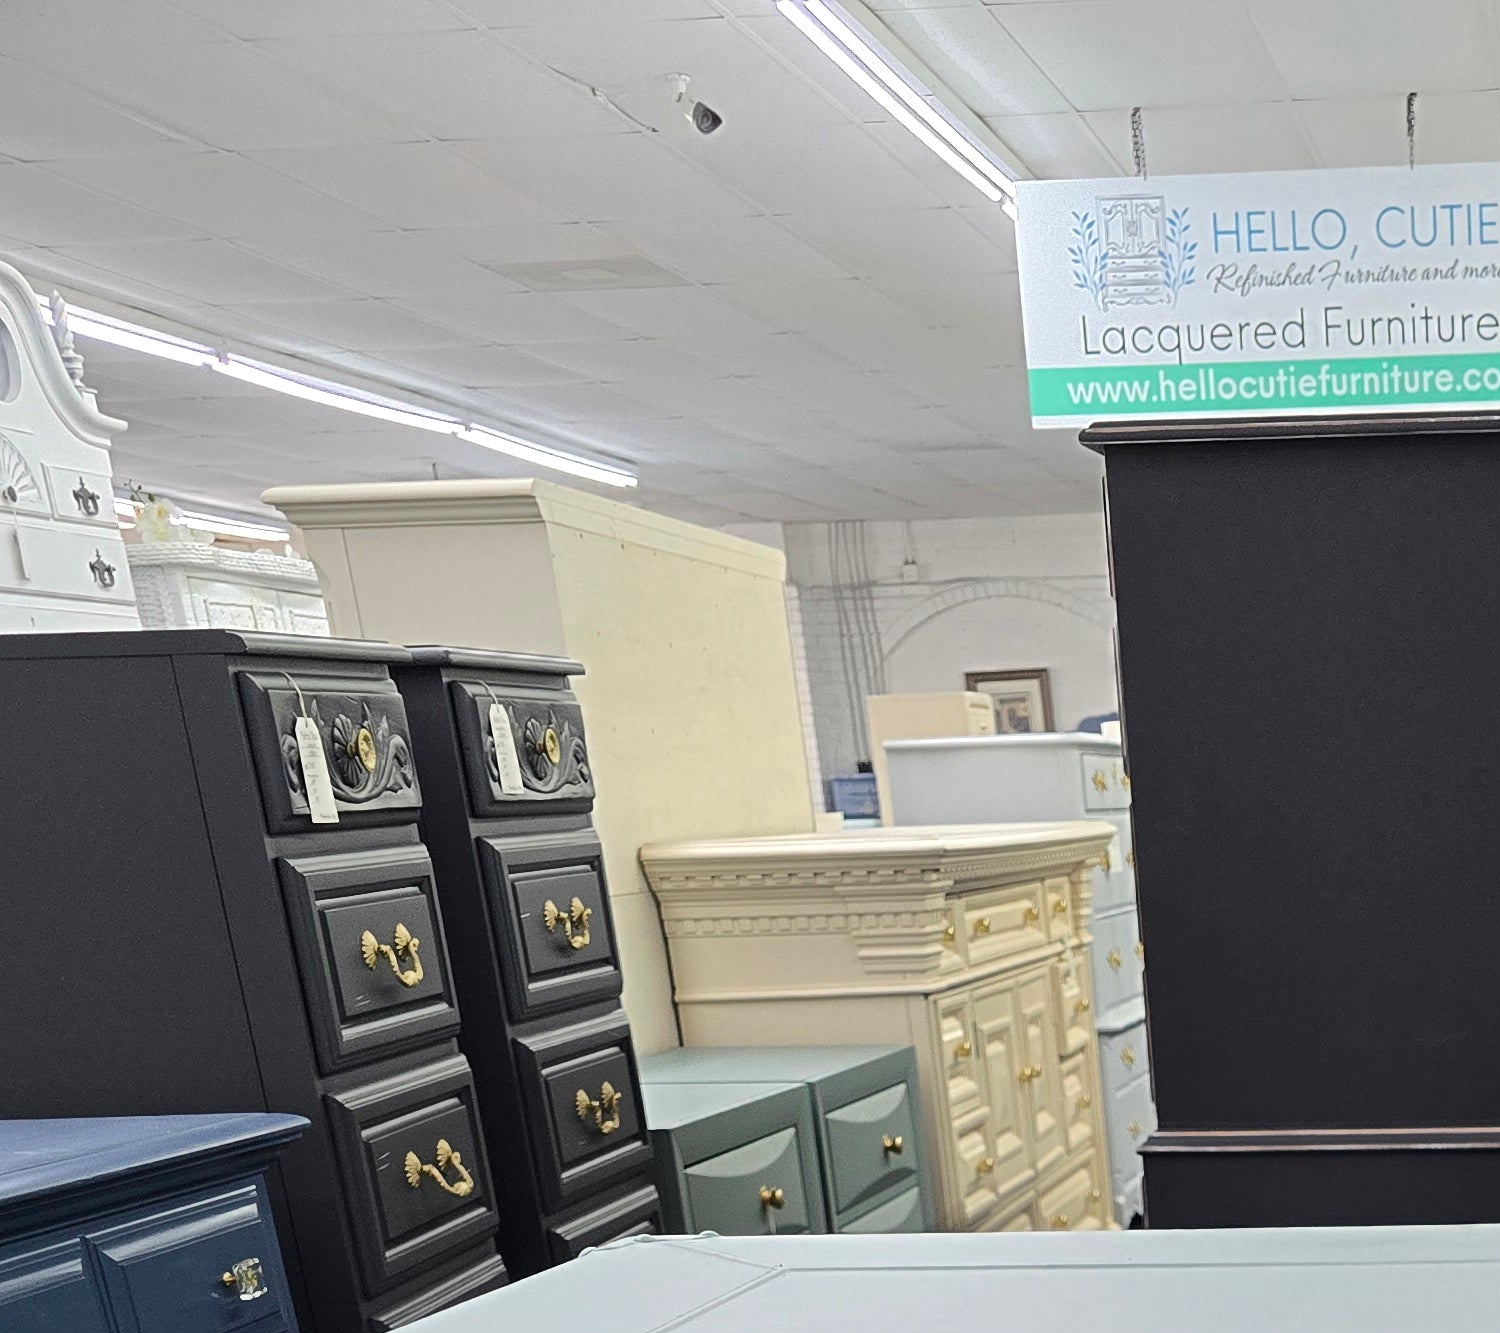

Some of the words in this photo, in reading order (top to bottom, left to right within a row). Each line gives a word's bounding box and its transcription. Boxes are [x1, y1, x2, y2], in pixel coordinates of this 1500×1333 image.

[1211, 207, 1360, 260] HELLO,
[1376, 202, 1500, 249] CUTIE
[1206, 263, 1315, 299] Refinished
[1316, 258, 1417, 292] Furniture
[1421, 259, 1458, 281] and
[1080, 306, 1305, 365] Lacquered
[1323, 302, 1500, 348] Furniture
